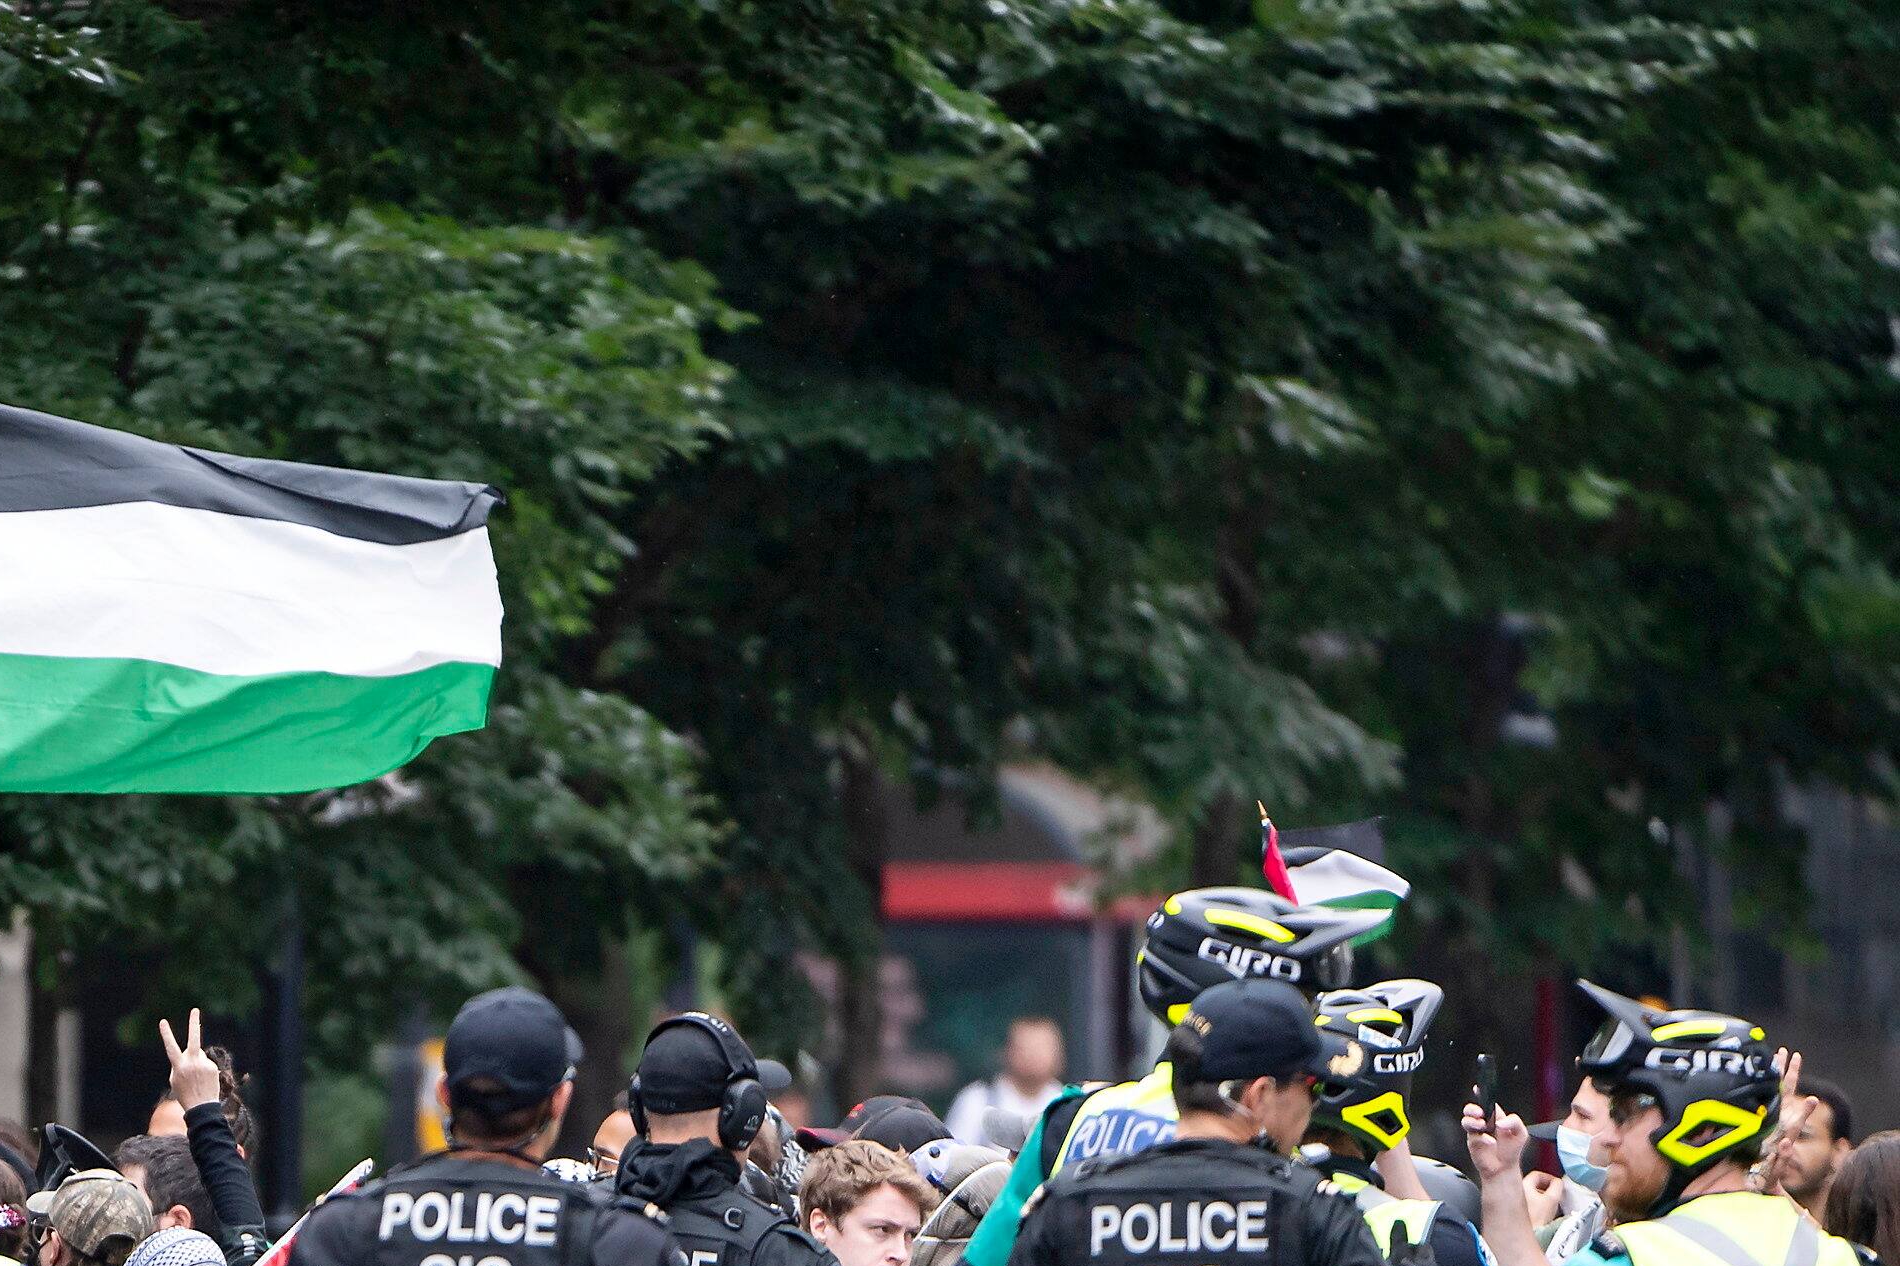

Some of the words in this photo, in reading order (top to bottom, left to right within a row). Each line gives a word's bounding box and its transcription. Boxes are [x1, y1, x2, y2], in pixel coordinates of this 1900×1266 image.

[1198, 937, 1301, 982] GIRO
[378, 1191, 561, 1246] POLICE
[1090, 1200, 1268, 1256] POLICE
